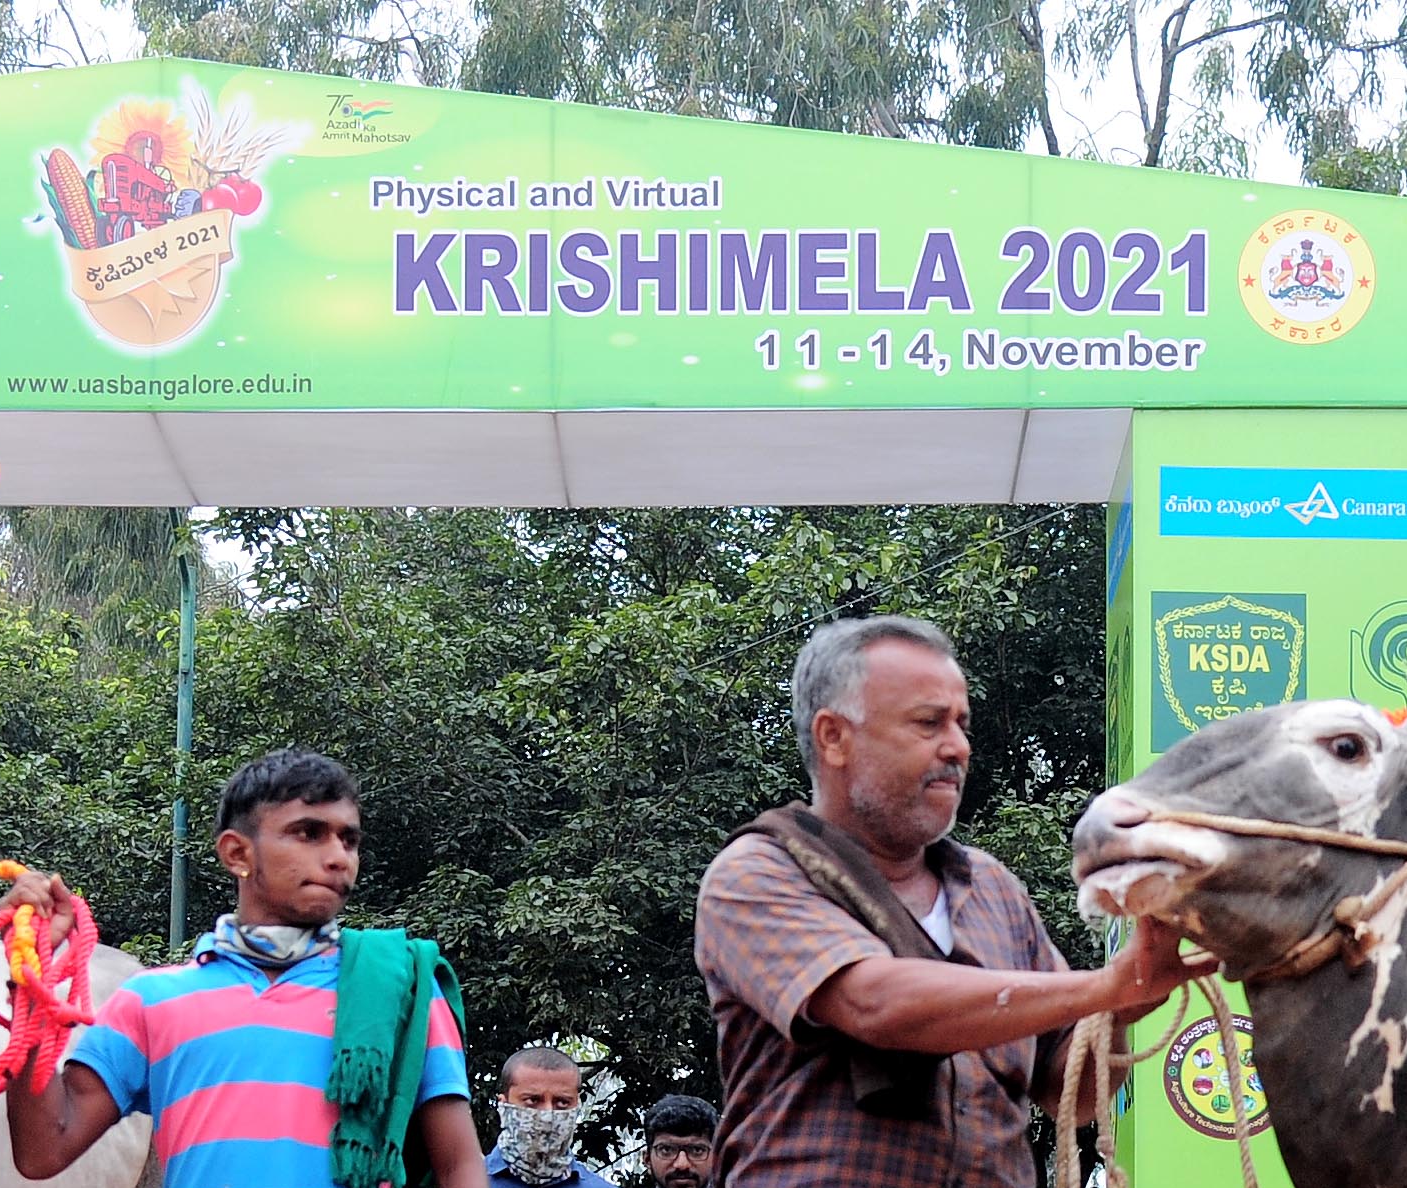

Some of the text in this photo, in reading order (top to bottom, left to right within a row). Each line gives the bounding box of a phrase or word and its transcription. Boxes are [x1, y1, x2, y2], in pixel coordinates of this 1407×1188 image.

[322, 131, 411, 143] Amrit Mahotsav
[326, 119, 376, 132] Azadi Ka
[372, 179, 721, 213] Physical and Virtual
[1257, 216, 1358, 244] ಕರ್ನಾಟಕ
[86, 224, 221, 291] ಕೃಷಿಮೇಳ 2021
[393, 230, 1209, 312] KRISHIMELA 2021
[1269, 317, 1342, 340] ಸರ್ಕಾರ
[967, 333, 1201, 369] November
[7, 374, 312, 400] www.uasbangalore.edu.in
[1342, 498, 1407, 516] Canara
[1172, 621, 1291, 650] ಕರ್ನಾಟಕ ರಾಜ್ಯ
[1189, 643, 1270, 673] KSDA
[1211, 676, 1248, 704] ಕೃಷಿ
[1171, 1080, 1195, 1119] Agriculture
[1194, 1114, 1236, 1134] Technology
